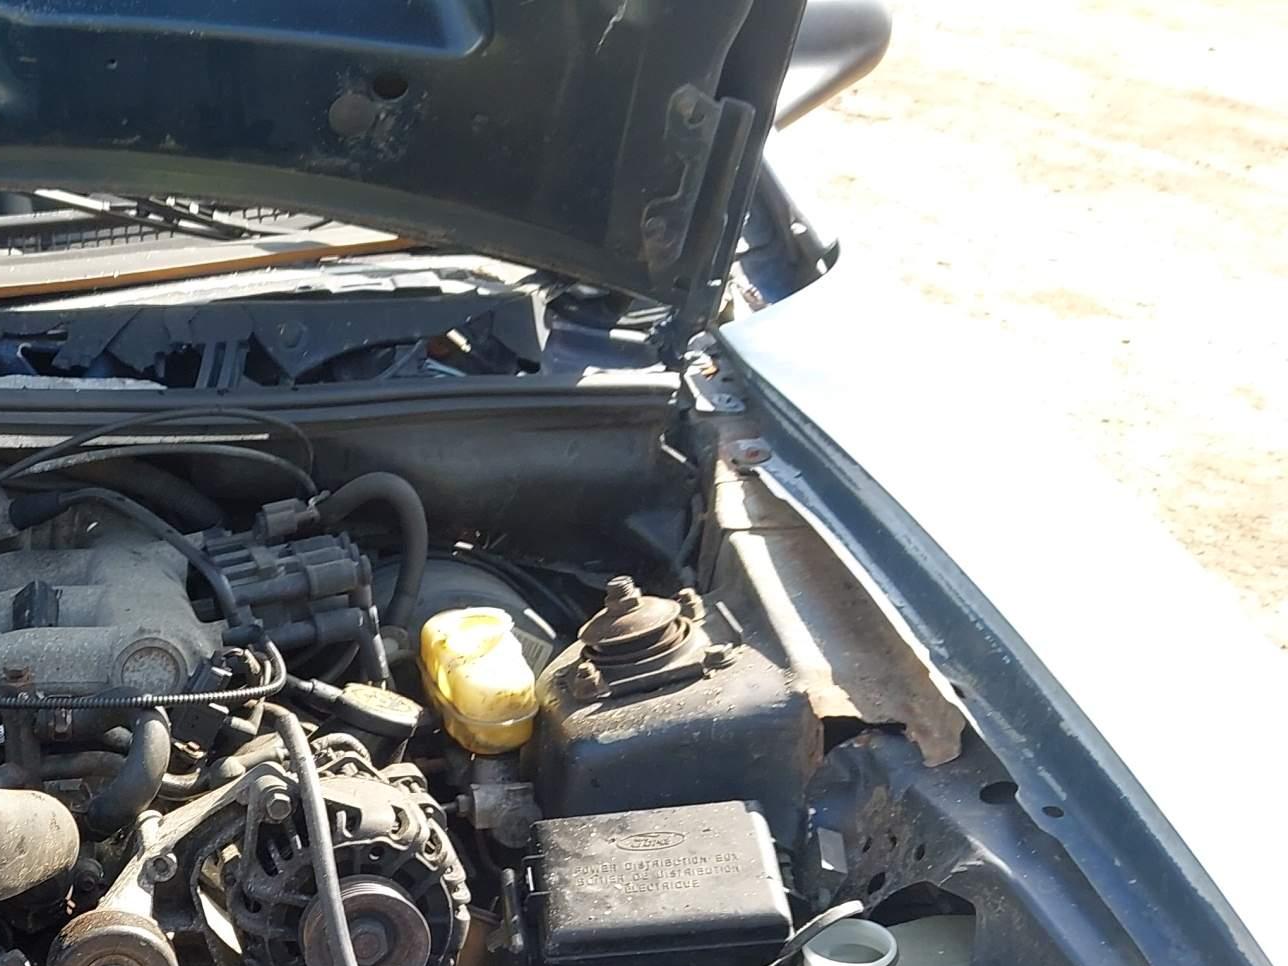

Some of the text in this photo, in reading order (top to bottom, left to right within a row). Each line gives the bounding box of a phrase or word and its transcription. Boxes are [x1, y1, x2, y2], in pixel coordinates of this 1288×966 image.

[574, 863, 617, 875] POWER
[624, 855, 708, 871] DISTRIBUTION
[656, 864, 740, 879] DISTRIBUTION
